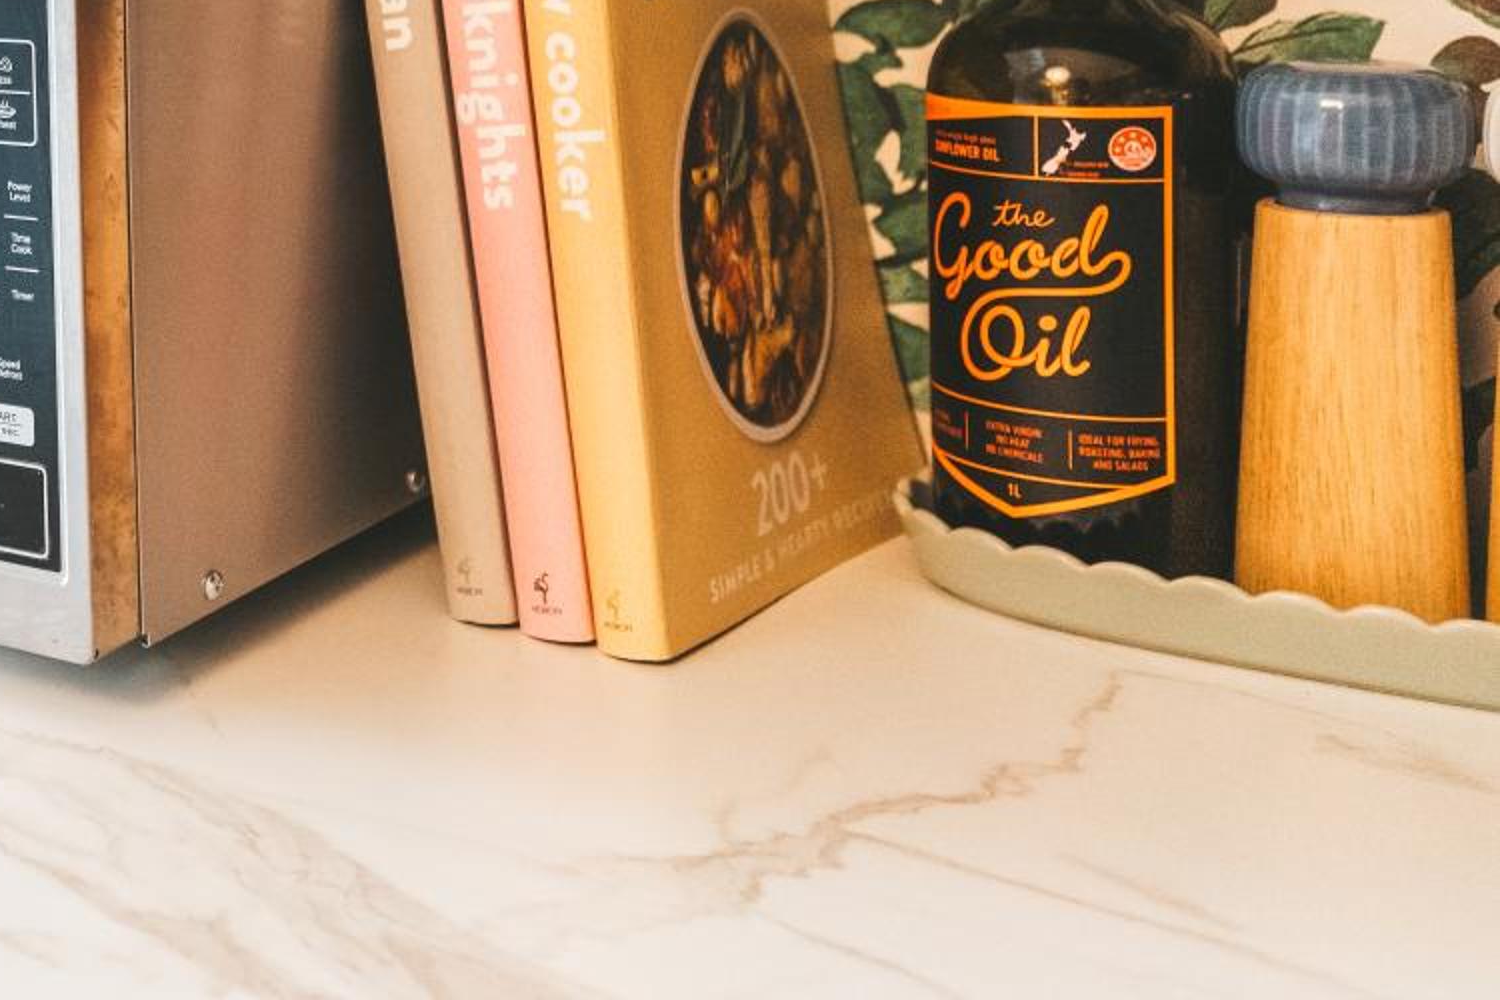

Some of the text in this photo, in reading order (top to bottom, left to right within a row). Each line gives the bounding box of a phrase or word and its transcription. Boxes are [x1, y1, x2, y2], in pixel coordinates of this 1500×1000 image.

[545, 32, 605, 223] cooker
[7, 181, 32, 192] Power
[9, 192, 31, 203] Level
[992, 199, 1056, 227] the
[934, 192, 1131, 300] Good
[961, 302, 1091, 381] Oil
[751, 451, 828, 536] 200+
[1007, 482, 1022, 499] 1L
